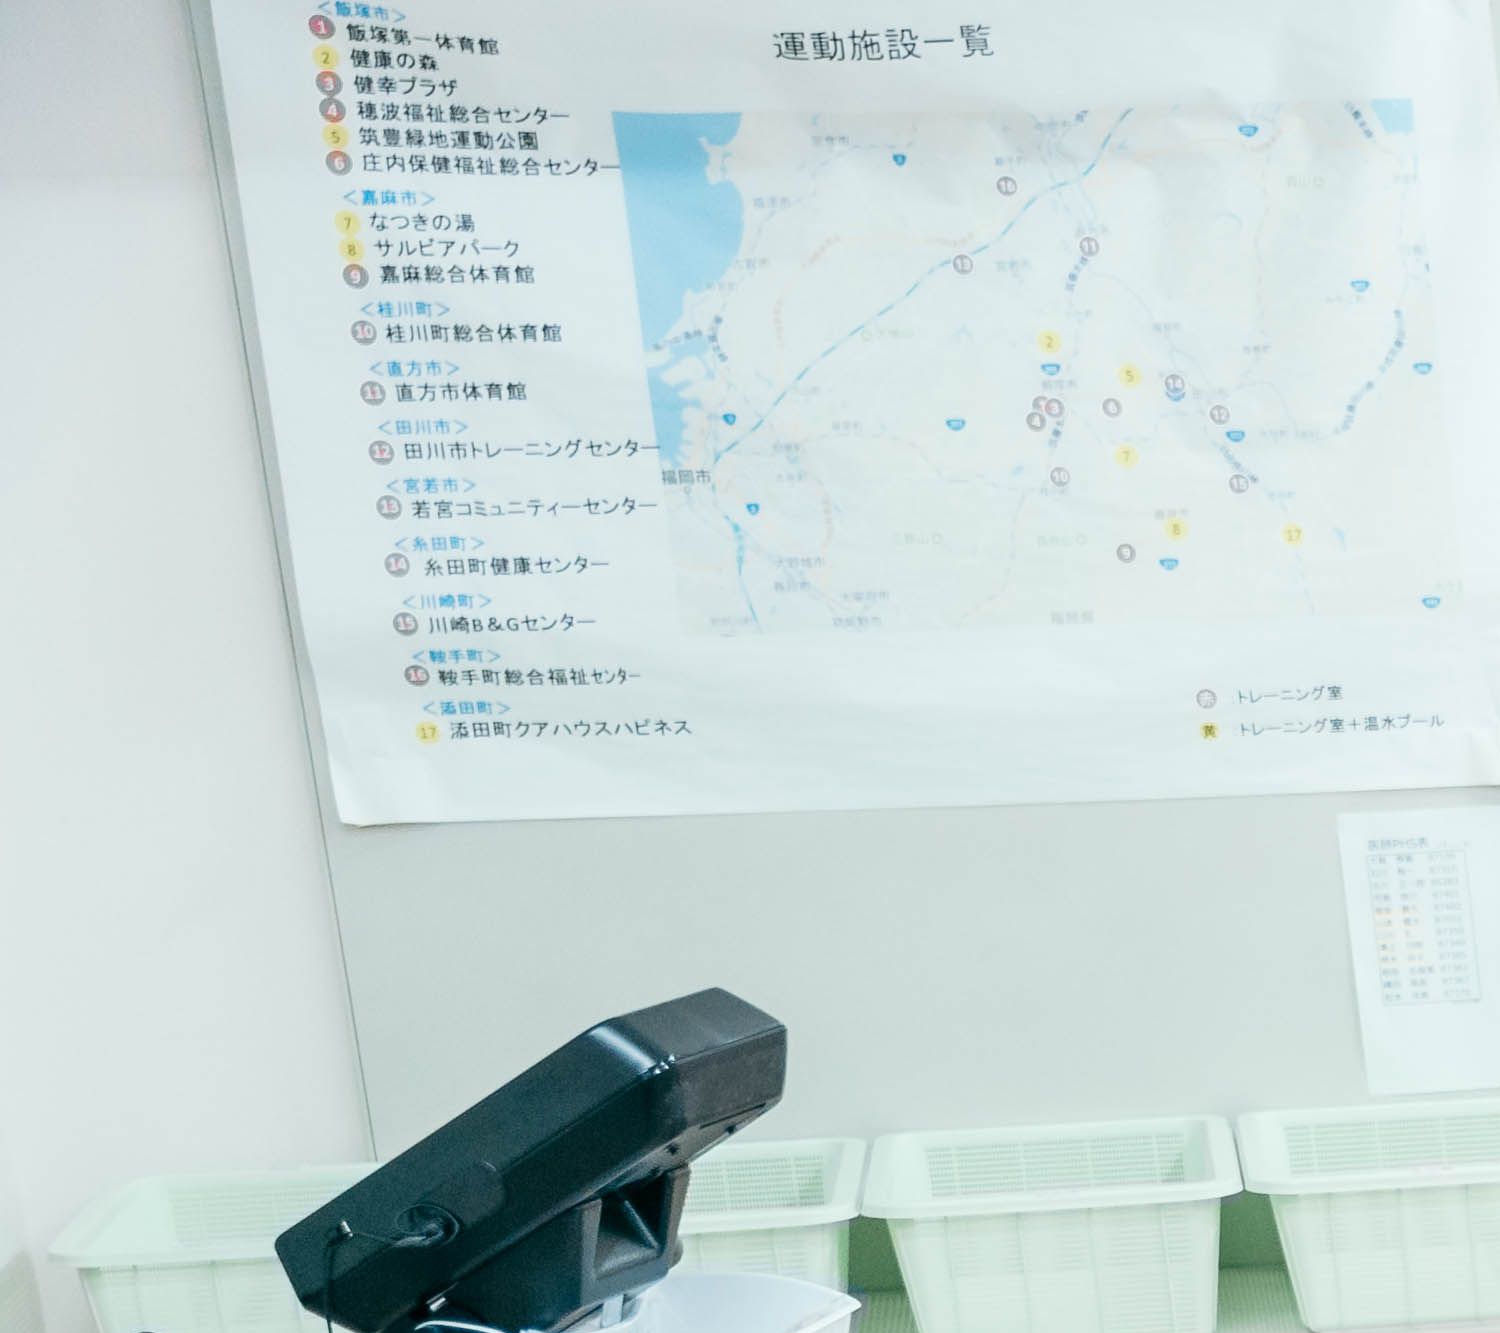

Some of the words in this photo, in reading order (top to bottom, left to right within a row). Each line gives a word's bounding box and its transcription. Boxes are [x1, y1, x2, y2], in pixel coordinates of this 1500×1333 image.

[346, 23, 500, 56] 飯塚第一体育館
[773, 24, 994, 62] 運動施設一覧
[350, 47, 440, 71] 健康の森
[354, 74, 458, 97] 健幸プラザ
[356, 100, 570, 125] 穂波福祉総合センター
[357, 126, 539, 151] 筑豊緑地運動公園
[362, 152, 621, 177] 庄内保健福祉総合センター
[369, 213, 475, 234] なつきの湯
[373, 238, 520, 259] サルビアパーク
[380, 264, 535, 286] 嘉麻総合体育館
[386, 322, 562, 344] 桂川町総合体育館
[395, 381, 527, 403] 直方市体育館
[404, 438, 661, 461] 田川市トレーニングセンター
[661, 469, 712, 486] 福岡市
[411, 497, 659, 520] 若宮コミュニティーセンター
[424, 554, 610, 577] 糸田町健康センター
[428, 613, 597, 635] 川崎B&Gセンター
[437, 665, 641, 687] 鞍手町総合福祉センター
[1237, 684, 1343, 705] トレーニング室
